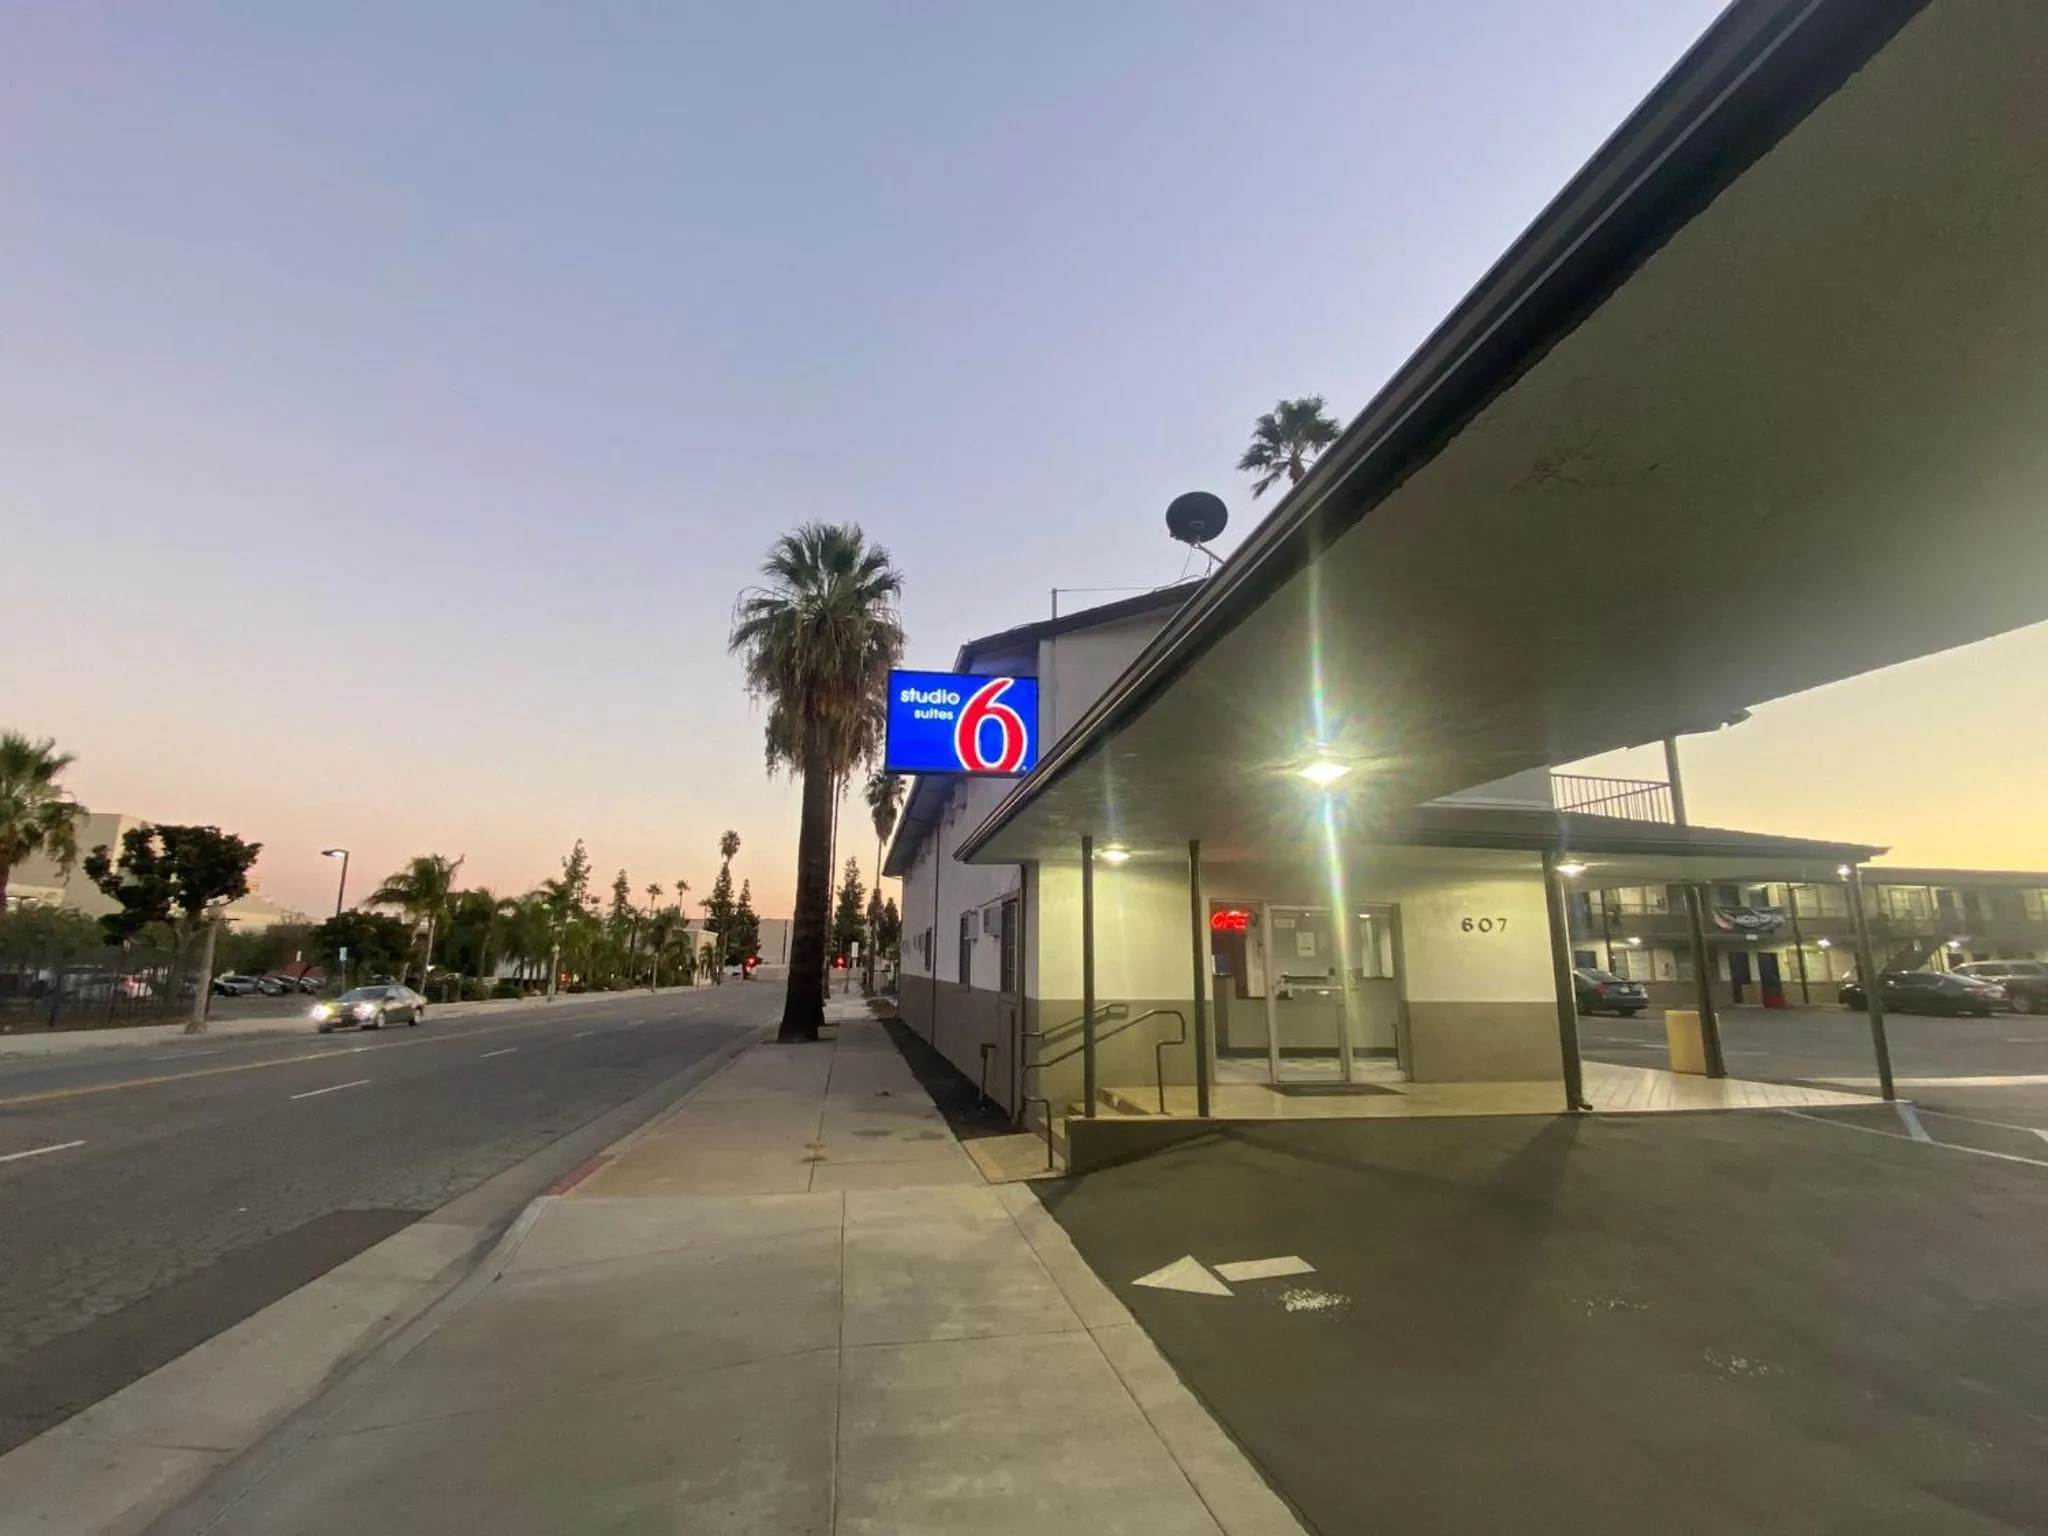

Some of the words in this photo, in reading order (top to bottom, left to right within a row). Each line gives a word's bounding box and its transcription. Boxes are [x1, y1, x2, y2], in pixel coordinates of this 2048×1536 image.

[900, 688, 960, 705] studio
[914, 708, 954, 721] suites
[954, 677, 1028, 772] 6
[1461, 917, 1508, 933] 607
